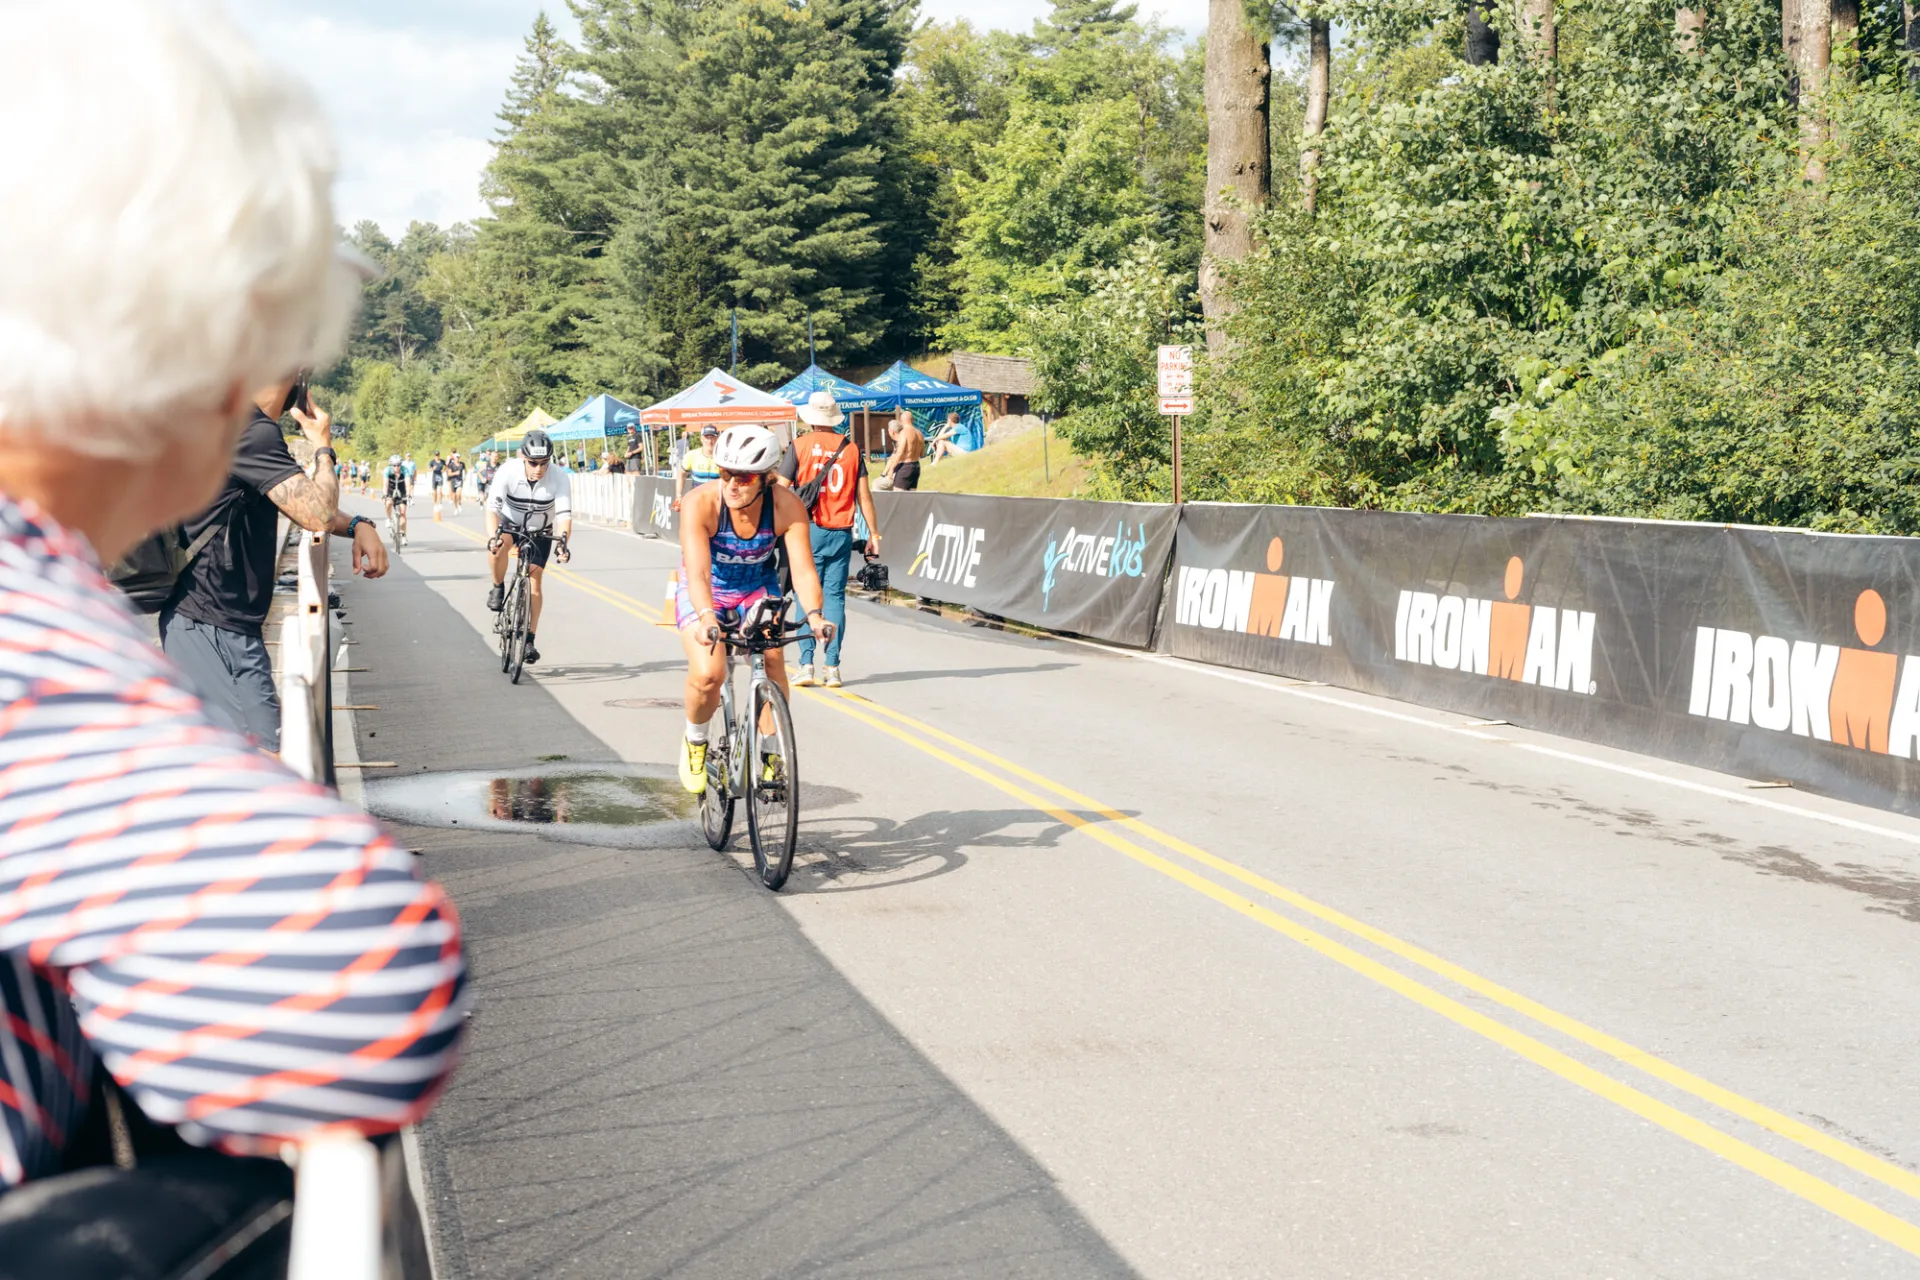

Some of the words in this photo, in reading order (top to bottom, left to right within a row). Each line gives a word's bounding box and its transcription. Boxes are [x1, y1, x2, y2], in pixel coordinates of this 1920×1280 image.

[905, 381, 948, 390] RTA
[1160, 362, 1189, 371] PARKIN
[1168, 351, 1181, 360] NO
[907, 512, 985, 588] ACTIVE
[1175, 565, 1335, 647] IRONMAN
[1395, 589, 1597, 694] IRONMAN
[1688, 625, 1920, 761] IRONMA
